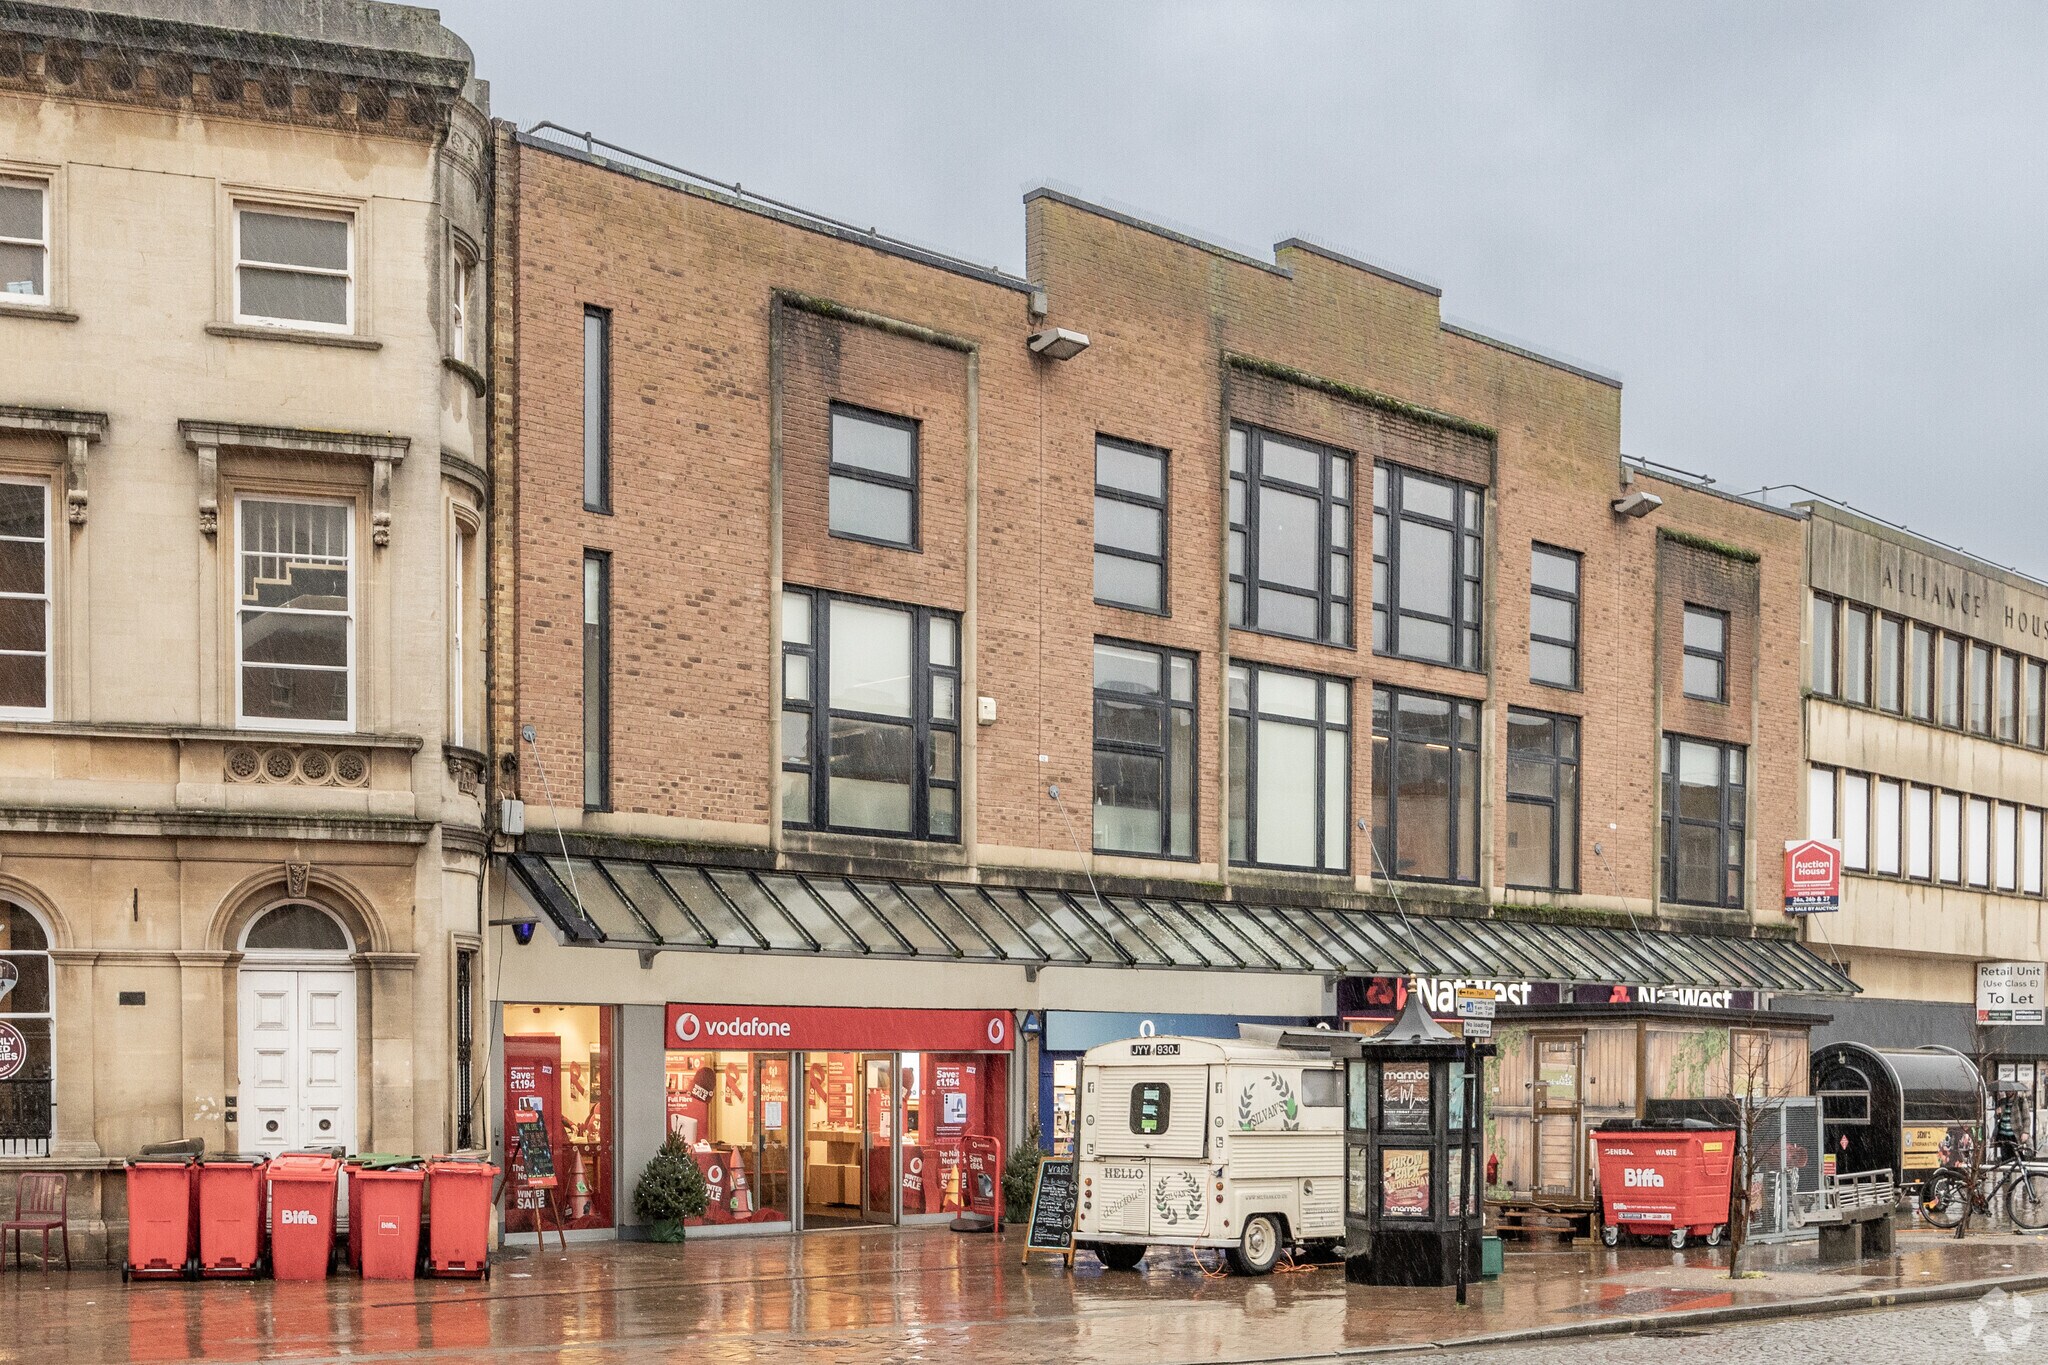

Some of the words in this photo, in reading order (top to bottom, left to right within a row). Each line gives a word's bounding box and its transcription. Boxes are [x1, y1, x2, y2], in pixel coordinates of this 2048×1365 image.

[1883, 566, 1981, 618] ALLIANCE
[1796, 860, 1830, 869] Auction
[1798, 867, 1826, 875] House
[1981, 966, 2013, 976] Retail
[2017, 966, 2041, 976] Unit
[1983, 980, 2002, 988] (Use
[2005, 979, 2027, 988] Class
[2030, 980, 2039, 988] E)
[1987, 992, 2005, 1004] To
[2011, 992, 2034, 1004] Let
[705, 1017, 791, 1036] vodafone
[1132, 1044, 1149, 1055] JYY
[1157, 1044, 1180, 1055] 930J
[511, 1070, 530, 1079] Save
[511, 1080, 535, 1089] £1,194
[936, 1079, 959, 1087] £1,194
[1251, 1102, 1285, 1127] SILVAN'S
[969, 1154, 983, 1163] Save
[1390, 1152, 1423, 1169] THROW
[1047, 1165, 1070, 1175] Wraps
[1104, 1168, 1144, 1179] HELLO
[1394, 1166, 1421, 1180] BACK
[1623, 1168, 1664, 1187] Biffa
[902, 1178, 922, 1191] SALE
[281, 1209, 318, 1225] Biffa
[381, 1221, 397, 1229] Biffa
